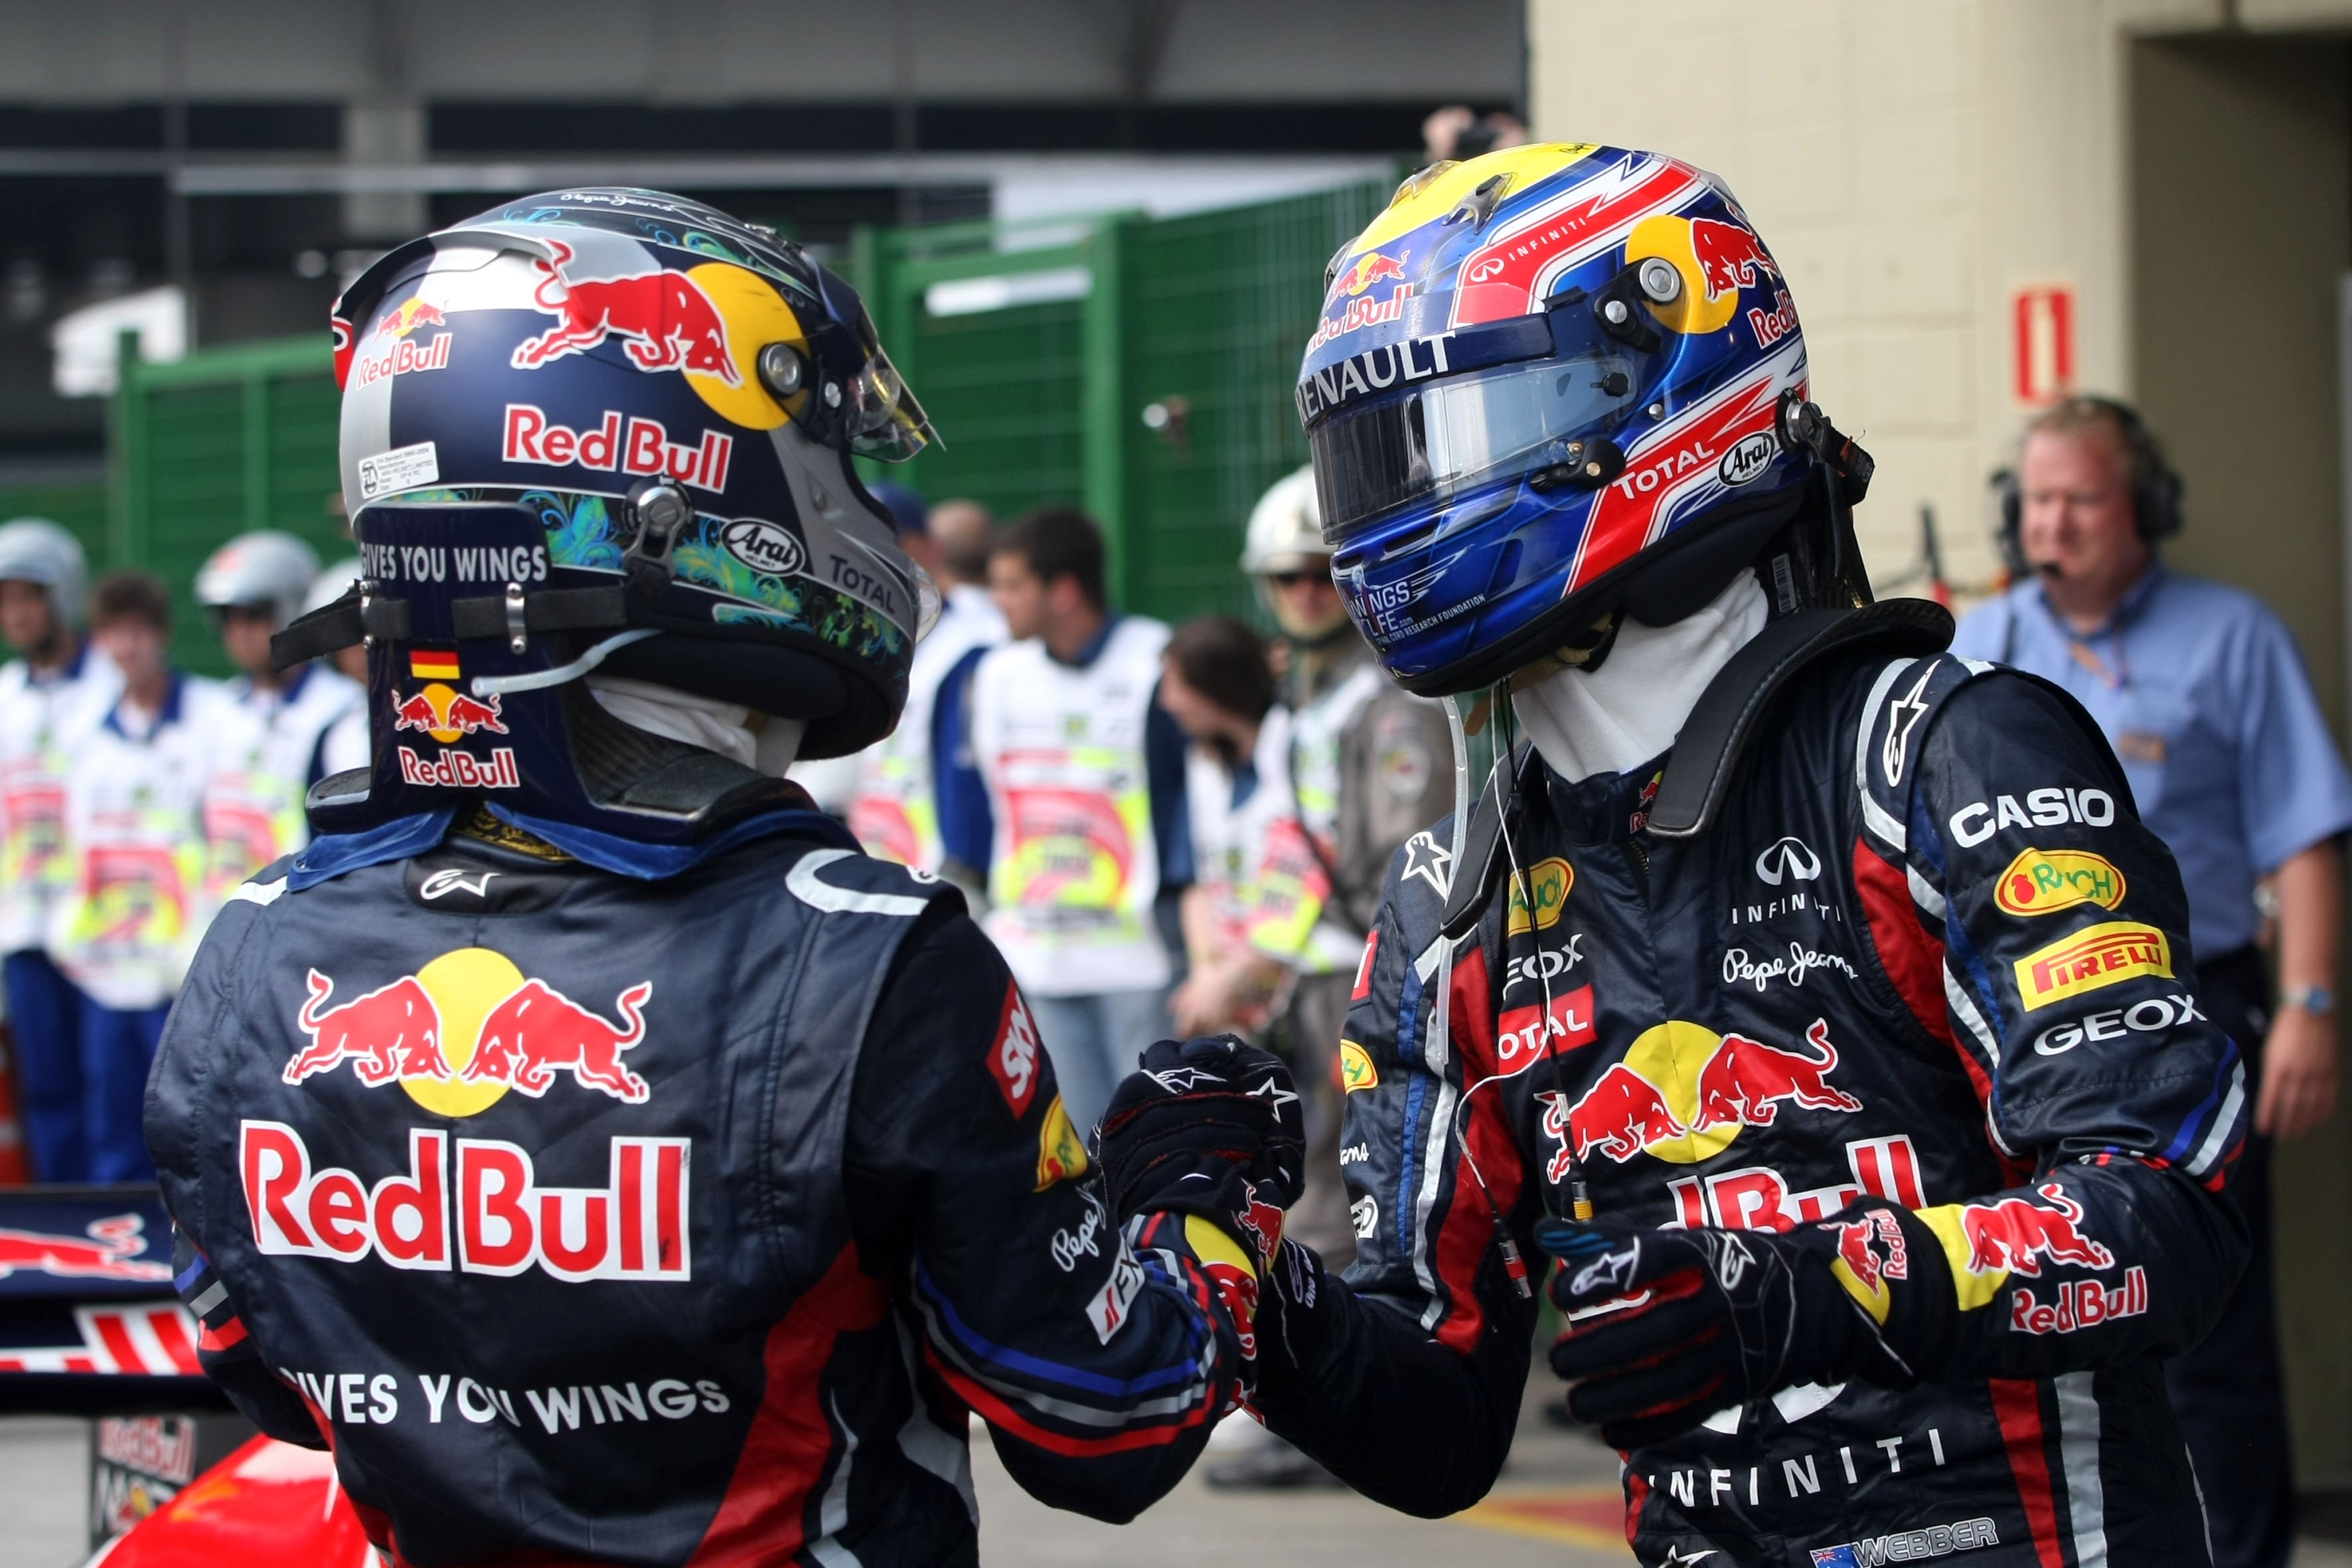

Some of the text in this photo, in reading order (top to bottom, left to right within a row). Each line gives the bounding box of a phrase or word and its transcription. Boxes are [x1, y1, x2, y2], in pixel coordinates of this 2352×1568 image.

[1508, 216, 1587, 262] INFINITI
[1610, 441, 1715, 500] TOTAL
[1725, 433, 1770, 481] Arai
[358, 545, 548, 583] GIVES YOU WINGS
[728, 526, 795, 566] Arai
[829, 553, 896, 615] TOTAL
[1404, 614, 1439, 637] RESEARCH
[1437, 593, 1486, 623] FOUNDATION
[1949, 787, 2114, 848] CASIO
[1508, 869, 1562, 918] AUCH
[1732, 892, 1842, 925] INFINITI
[1502, 934, 1584, 1000] EOX
[1723, 941, 1858, 992] Pepe Jeans
[2031, 931, 2162, 994] PIRELLI
[1499, 1008, 1589, 1061] OTAL
[2033, 994, 2208, 1056] GEOX
[1052, 1214, 1100, 1273] Pepe
[525, 1378, 731, 1435] WINGS
[1851, 1516, 1999, 1567] WEBBER
